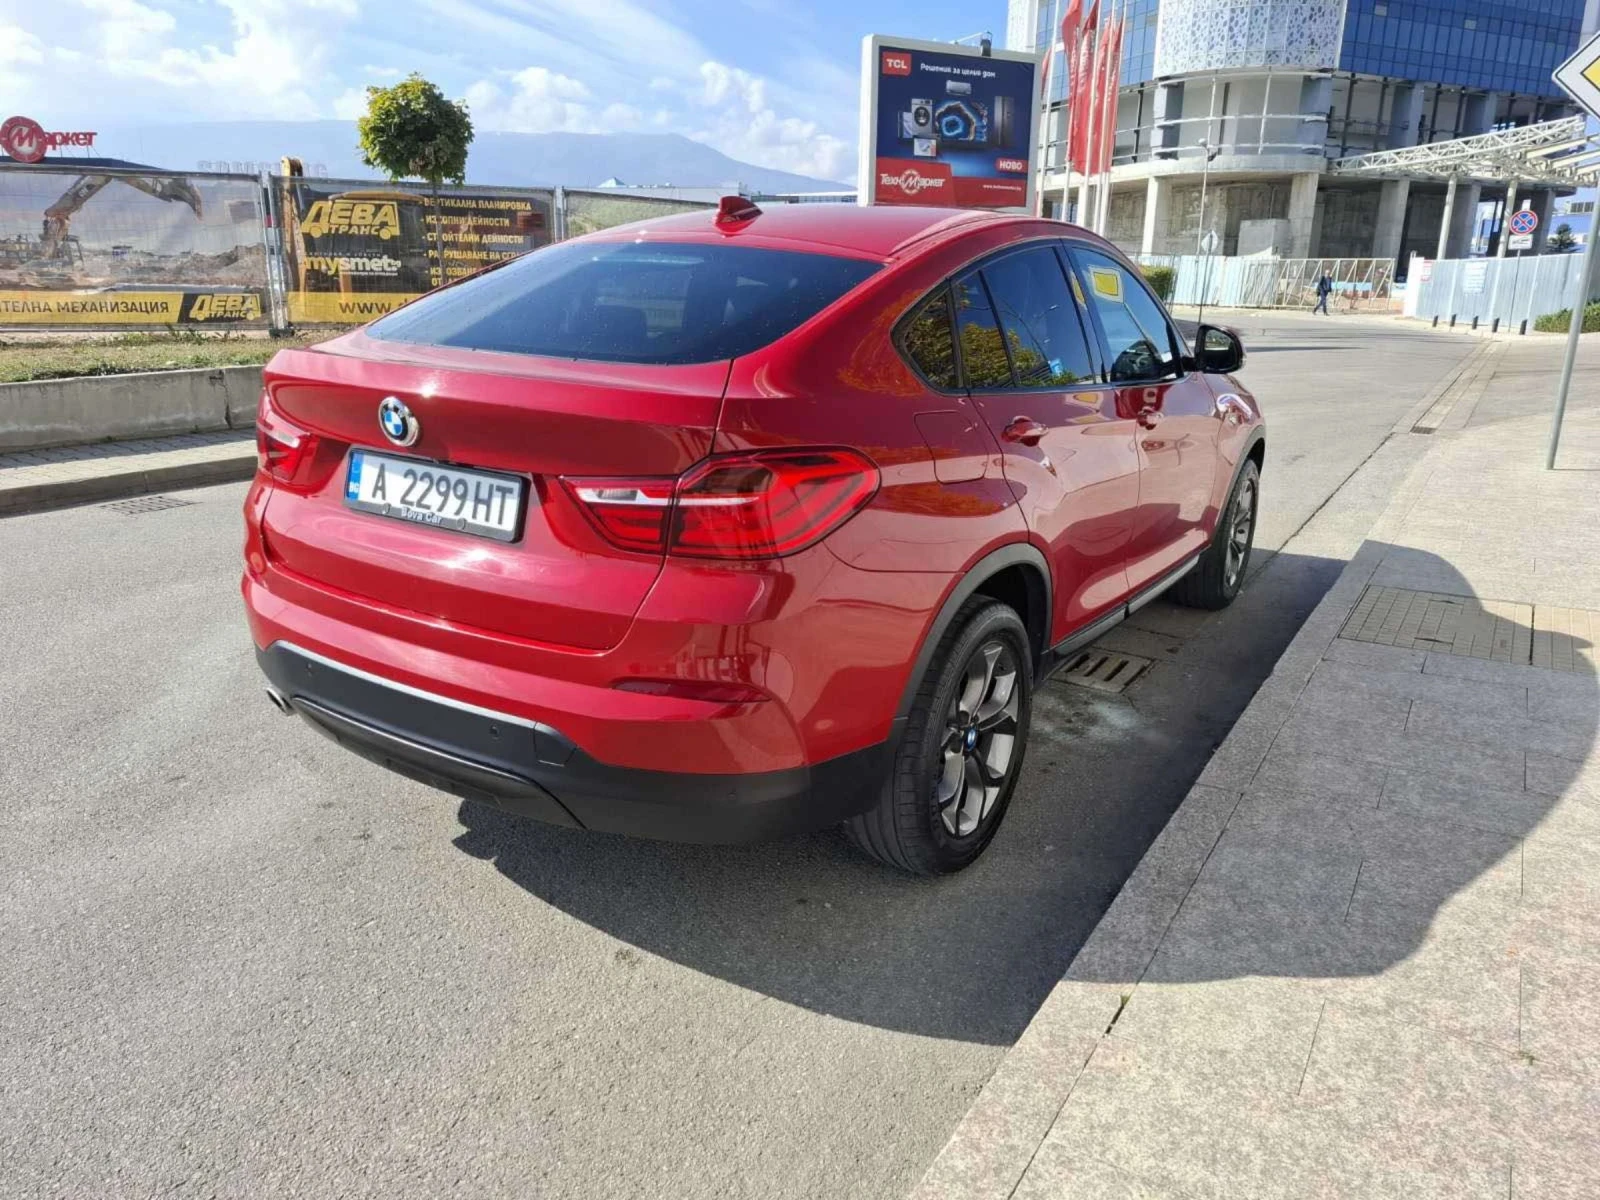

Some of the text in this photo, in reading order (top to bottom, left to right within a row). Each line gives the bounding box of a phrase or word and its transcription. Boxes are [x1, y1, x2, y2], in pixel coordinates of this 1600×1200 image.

[886, 58, 908, 69] TCL
[999, 160, 1023, 171] НОВО
[478, 200, 532, 211] ПЛАНИРОВКА
[301, 200, 397, 233] ДЕВА
[329, 224, 380, 235] ТРАНС
[428, 250, 489, 260] РАРУШАВАНЕ
[489, 251, 500, 260] НА
[430, 267, 477, 277] ИЗОЗВАНЕ
[0, 301, 169, 314] ТЕЛНА МЕХАНИЗАЦИЯ
[189, 294, 258, 319] ДЕВА
[208, 310, 247, 318] ТРАНС
[349, 481, 360, 493] BG
[372, 463, 387, 501] A
[425, 512, 442, 524] Car
